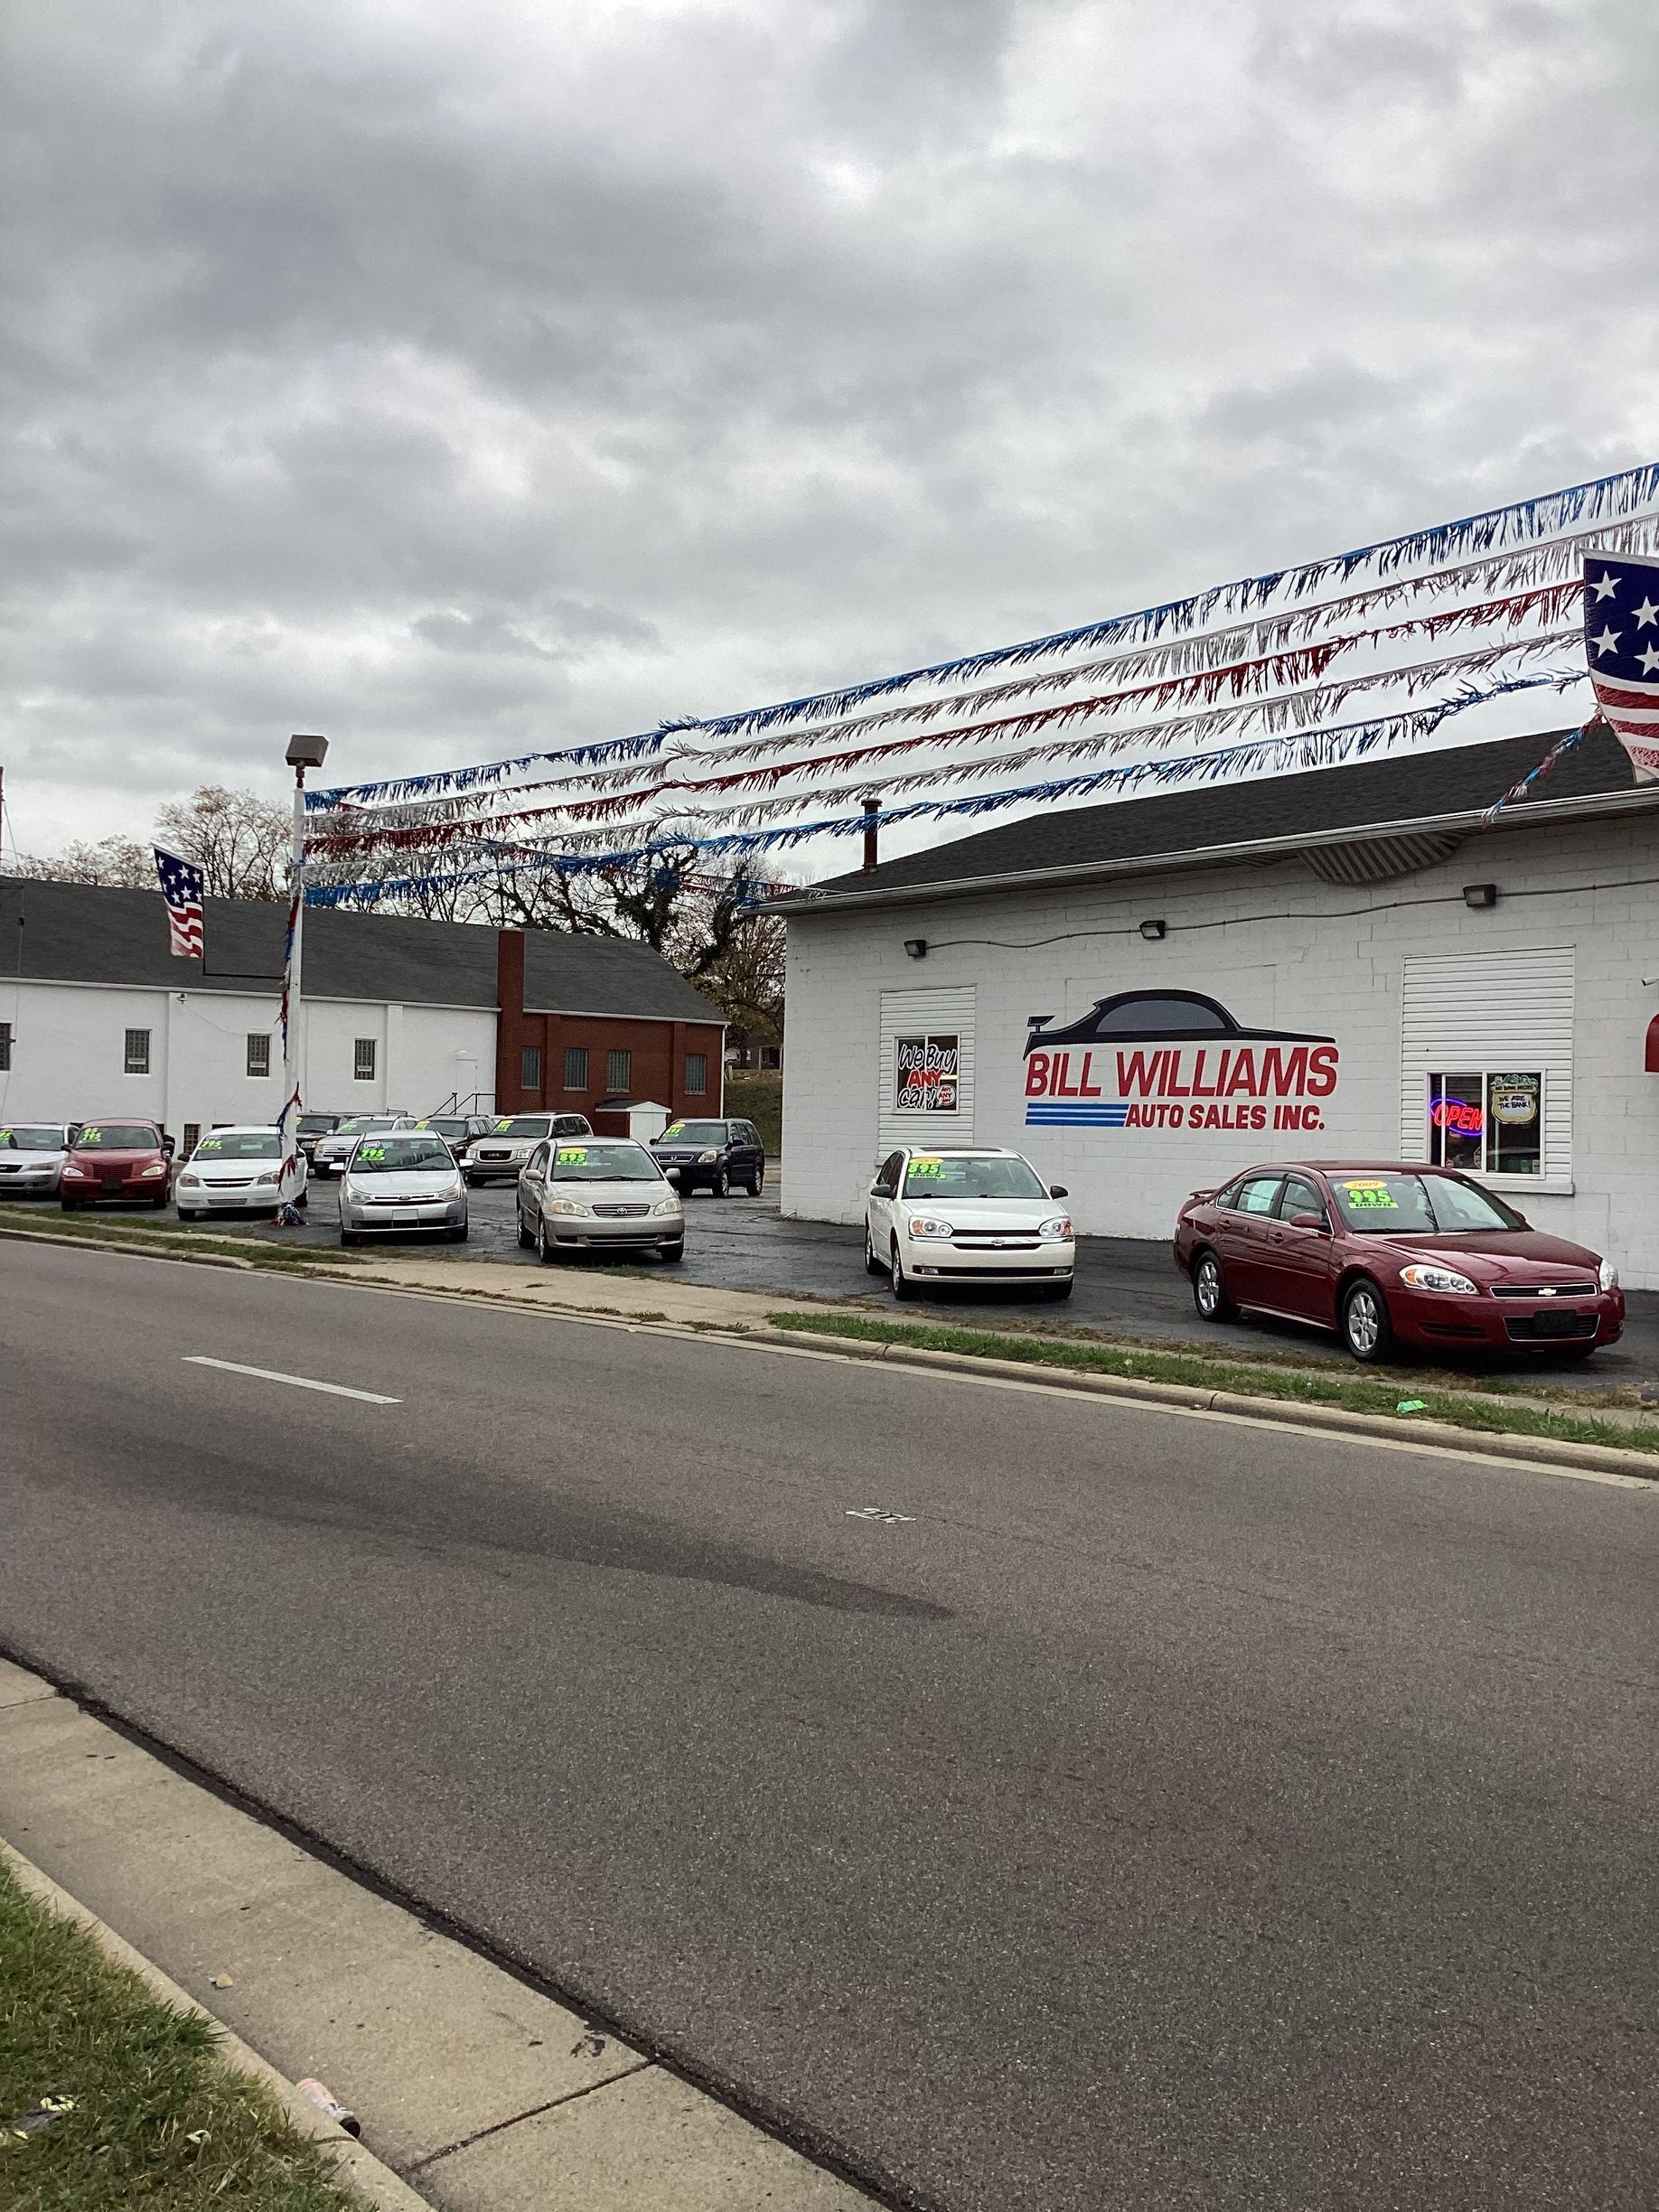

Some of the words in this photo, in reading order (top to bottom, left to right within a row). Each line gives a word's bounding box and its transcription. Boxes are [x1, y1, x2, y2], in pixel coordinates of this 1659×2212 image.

[898, 1044, 925, 1070] We
[926, 1044, 957, 1074] Buy
[906, 1069, 942, 1090] ANY
[1025, 1052, 1101, 1097] BILL
[1116, 1046, 1339, 1097] WILLIAMS
[1125, 1103, 1184, 1128] AUTO
[1189, 1103, 1266, 1129] SALES
[1273, 1104, 1326, 1130] INC.
[1433, 1103, 1484, 1130] OPEN
[361, 1148, 386, 1158] 795
[558, 1153, 586, 1162] 895
[907, 1163, 940, 1174] 895
[1348, 1190, 1392, 1203] 995
